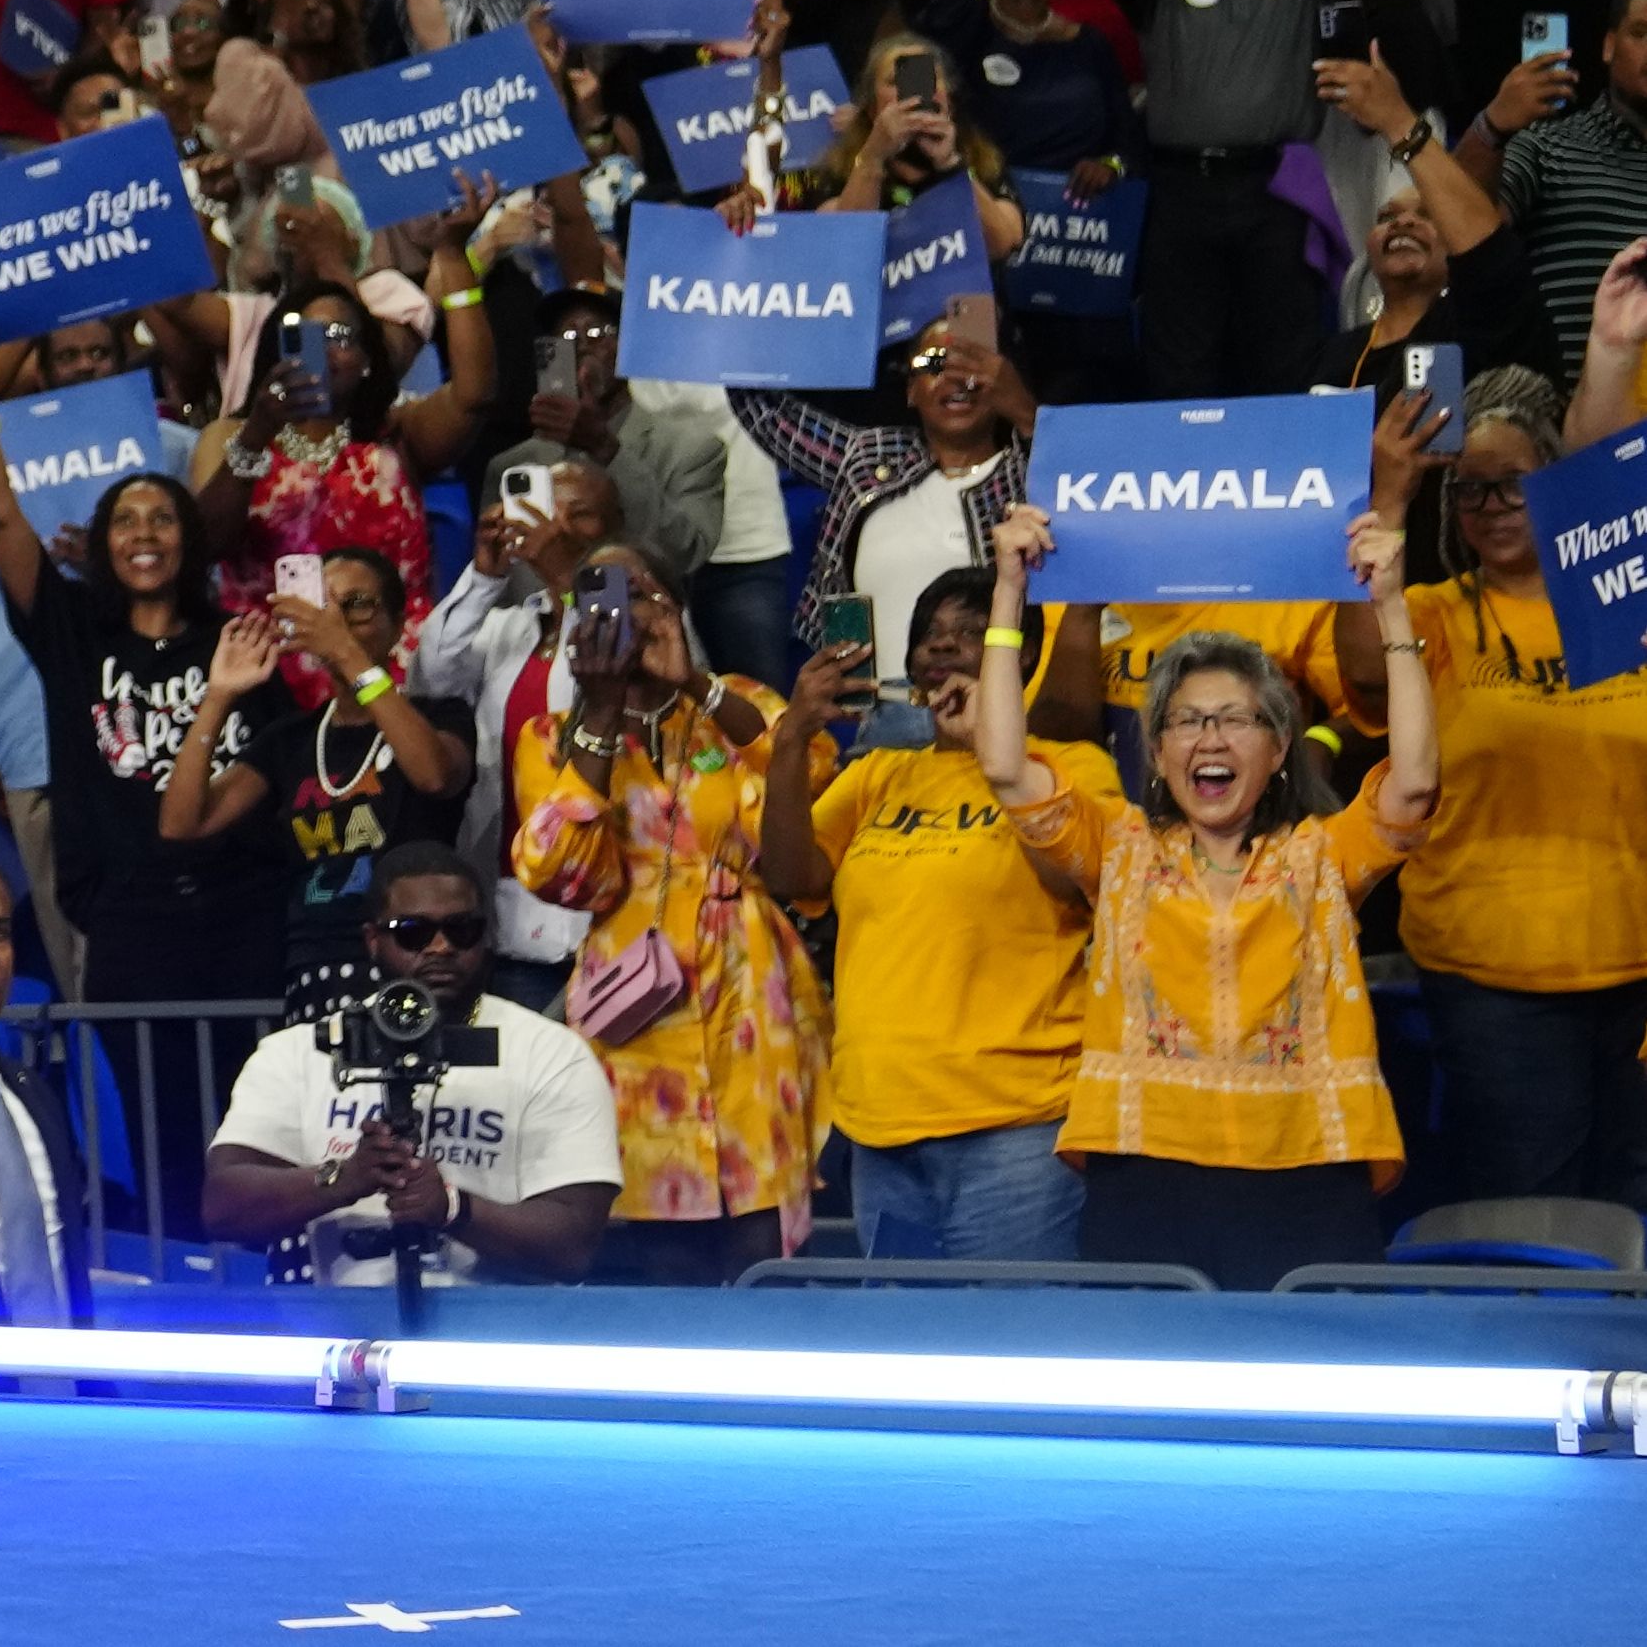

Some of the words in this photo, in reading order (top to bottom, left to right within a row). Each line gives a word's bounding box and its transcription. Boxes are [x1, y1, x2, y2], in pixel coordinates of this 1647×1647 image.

[337, 113, 420, 154] When
[419, 100, 462, 130] we
[459, 73, 538, 126] fight,
[676, 88, 836, 145] KAMLA
[377, 146, 438, 178] WE
[437, 118, 524, 164] WIN.
[38, 206, 83, 240] we
[82, 177, 172, 237] fight,
[55, 225, 152, 273] WIN.
[883, 229, 968, 289] KAM
[647, 276, 854, 318] KAMALA
[1056, 467, 1334, 513] KAMALA
[1554, 511, 1631, 571] When
[1592, 554, 1647, 606] WE
[326, 1099, 504, 1143] HARIS
